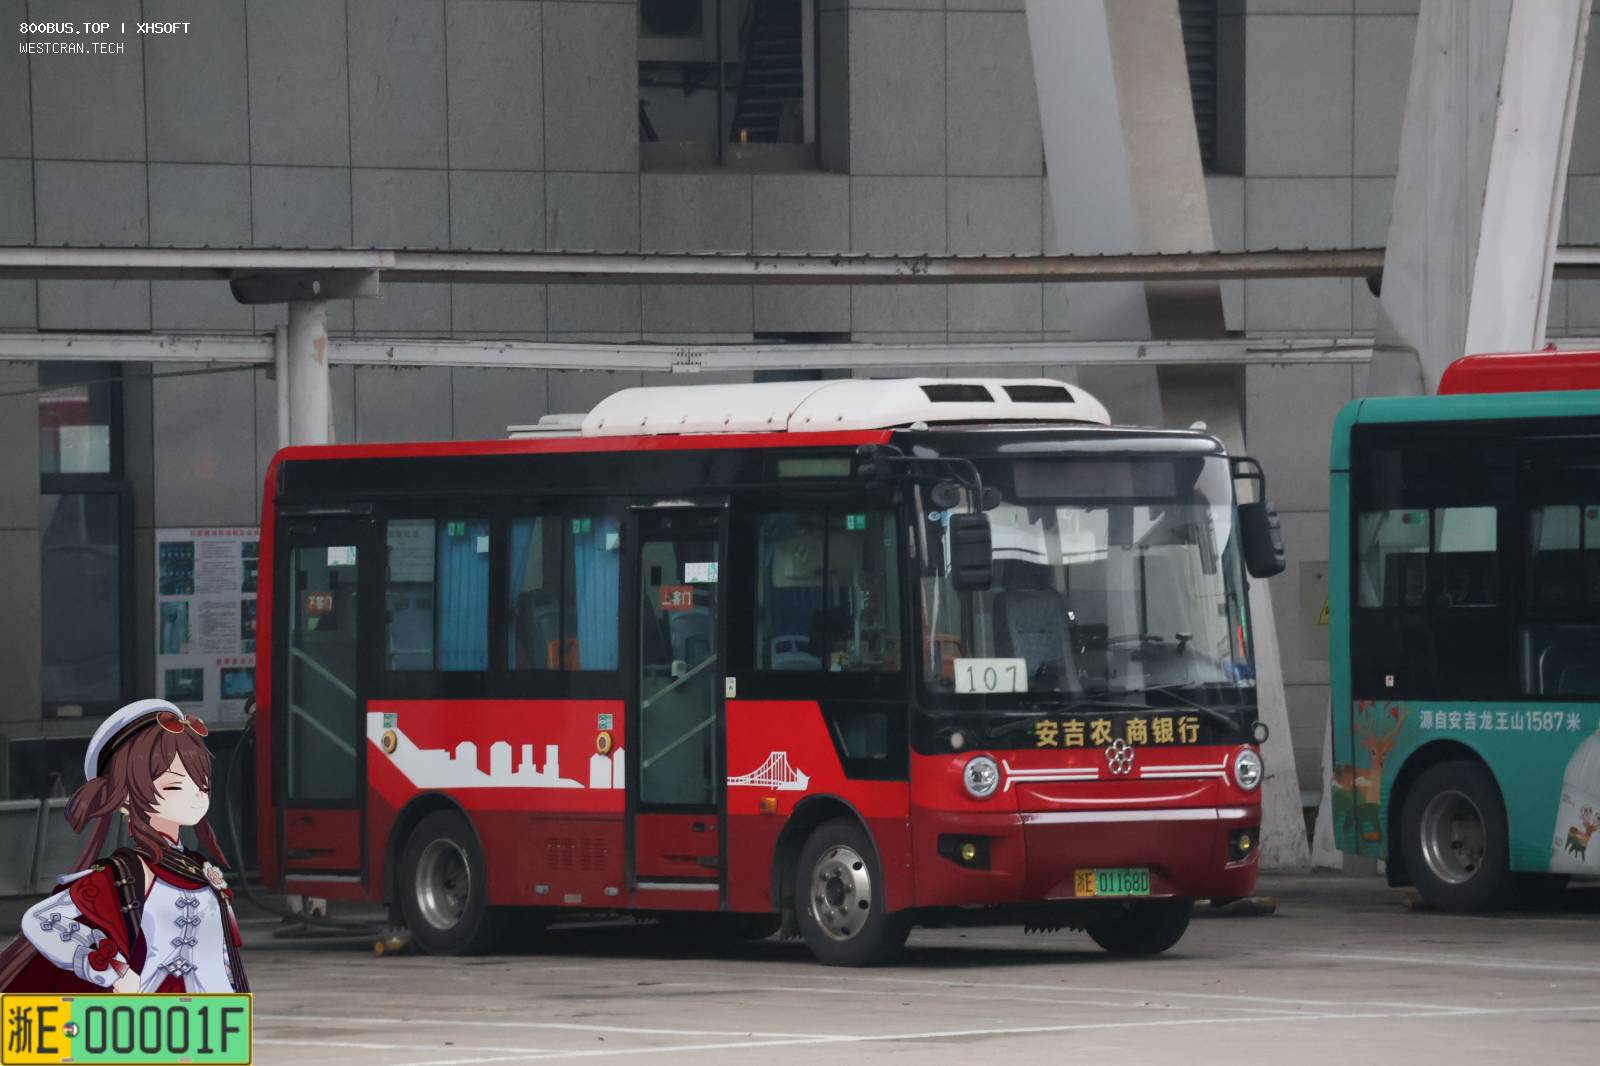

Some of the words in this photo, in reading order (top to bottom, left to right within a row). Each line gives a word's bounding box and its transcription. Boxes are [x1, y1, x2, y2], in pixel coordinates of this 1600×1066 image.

[661, 590, 691, 606] 上客门
[966, 665, 1017, 694] 107
[1419, 710, 1580, 732] 源自安吉龙王山1587米
